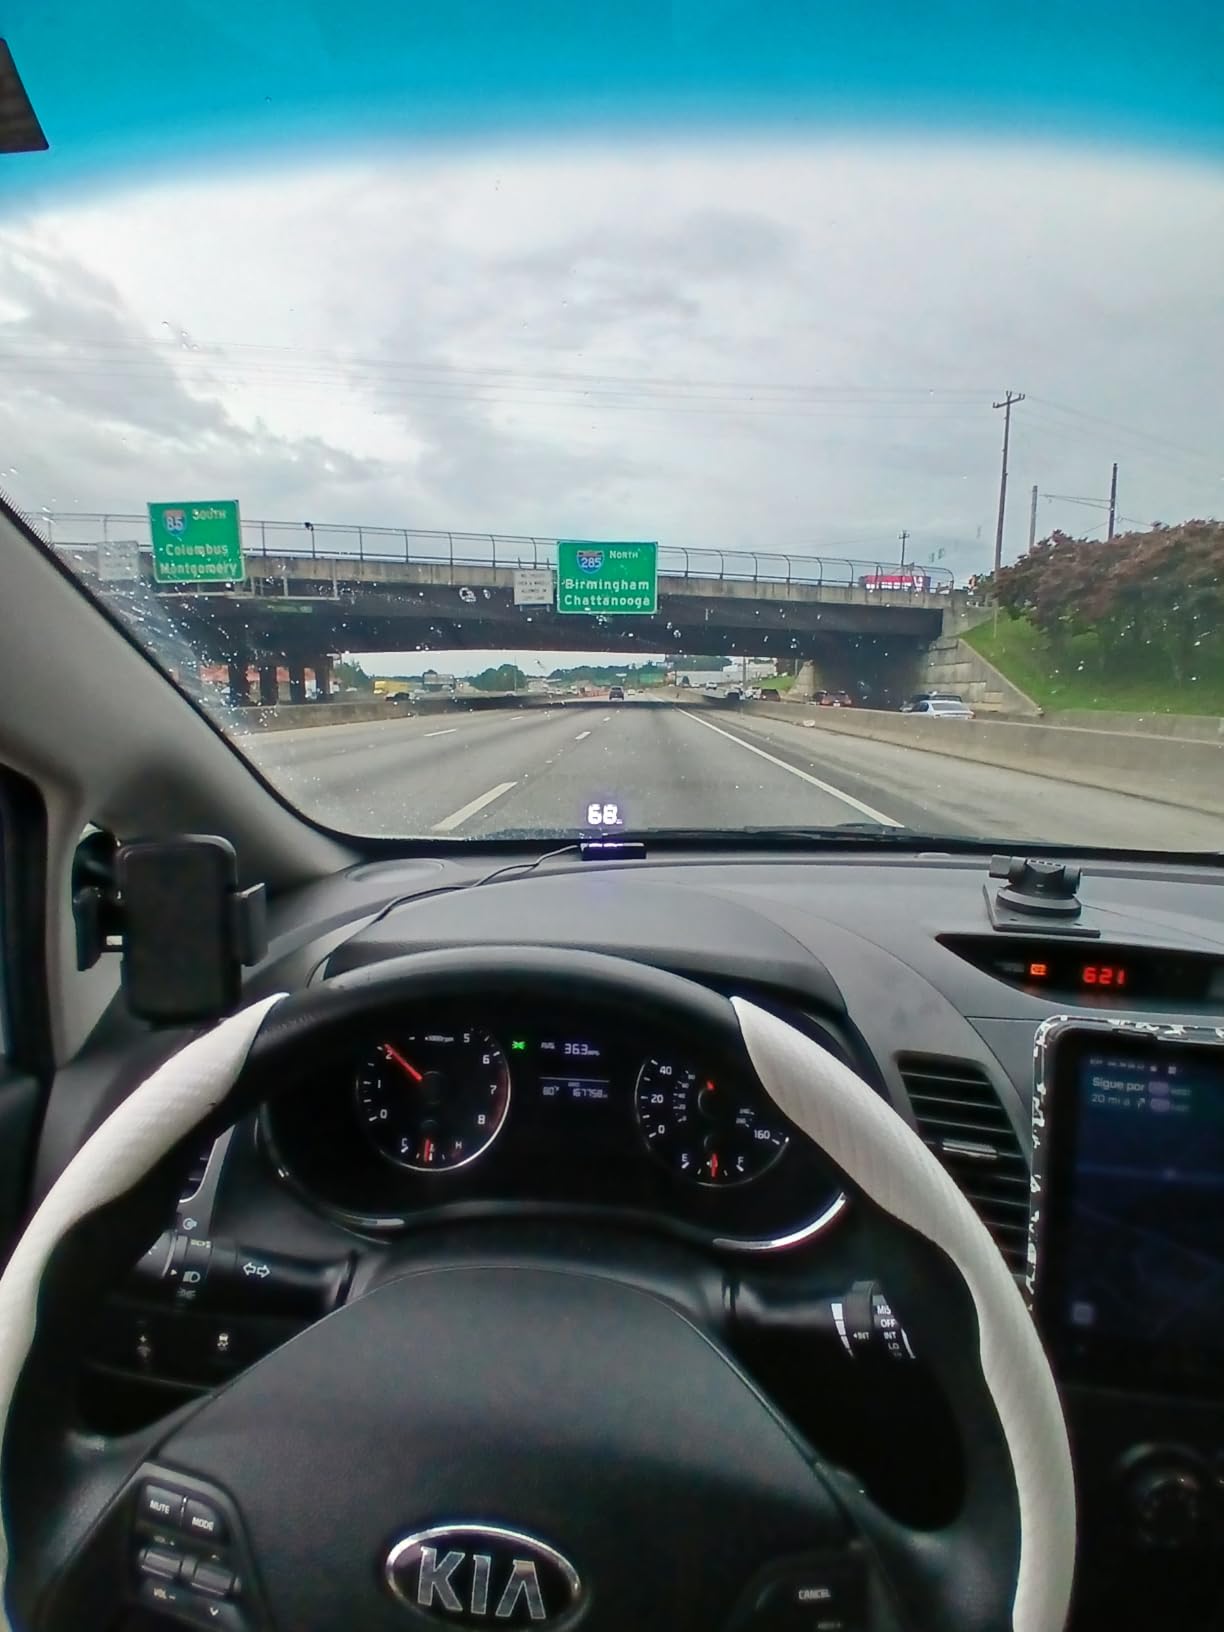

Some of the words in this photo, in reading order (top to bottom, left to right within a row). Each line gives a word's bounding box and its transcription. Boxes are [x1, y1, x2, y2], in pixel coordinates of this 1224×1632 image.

[166, 516, 183, 531] 85
[165, 543, 228, 556] Columbus
[609, 550, 639, 559] NORTH
[580, 557, 602, 568] 285
[160, 561, 237, 576] Montgomery
[564, 578, 649, 592] Birmingham
[564, 594, 650, 608] Chattanooga
[588, 803, 618, 825] 68
[463, 1033, 470, 1043] 5
[385, 1051, 393, 1060] 2
[482, 1054, 490, 1065] 6
[659, 1065, 673, 1076] 40
[377, 1079, 382, 1089] 1
[1092, 1076, 1124, 1091] Sigue
[490, 1084, 497, 1095] 7
[651, 1093, 664, 1104] 20
[380, 1108, 388, 1119] 0
[477, 1114, 486, 1125] 8
[658, 1124, 666, 1134] 0
[753, 1129, 771, 1140] 160
[681, 1153, 688, 1162] E
[737, 1156, 744, 1165] F
[880, 1318, 897, 1328] OFF
[150, 1500, 170, 1514] MUTE
[192, 1517, 214, 1531] MODE
[417, 1546, 546, 1620] KIA
